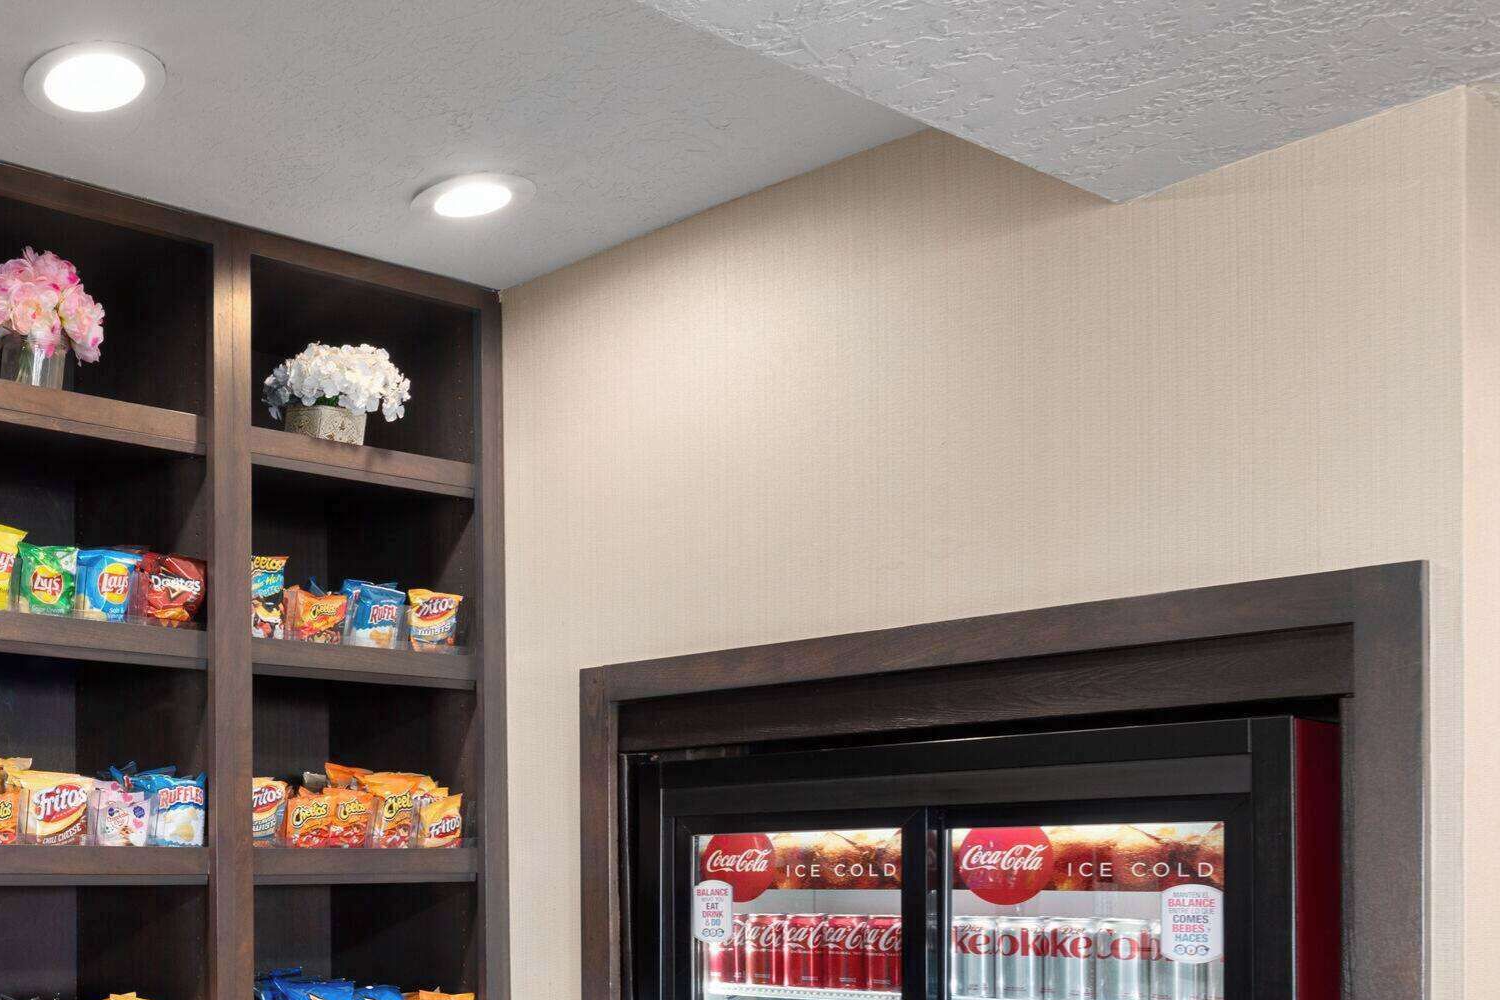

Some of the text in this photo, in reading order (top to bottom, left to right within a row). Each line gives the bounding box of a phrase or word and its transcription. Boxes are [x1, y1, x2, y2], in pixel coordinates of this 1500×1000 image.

[101, 573, 129, 594] Lay's
[151, 575, 201, 593] Doritos
[33, 785, 89, 821] Fritos
[159, 786, 204, 809] RUFFLES
[292, 800, 329, 828] Cheetos
[58, 824, 82, 841] CHEESE
[429, 816, 461, 838] Fritos
[706, 848, 773, 873] Coca-Cola
[961, 843, 1049, 871] Coca-Cola
[786, 863, 896, 878] ICE COLD
[1067, 862, 1214, 878] ICE COLD
[697, 888, 728, 896] BALANCE
[1168, 898, 1215, 908] BALANCE
[1173, 914, 1209, 924] COMES
[1172, 924, 1204, 933] BEBES
[1175, 933, 1208, 942] HACES
